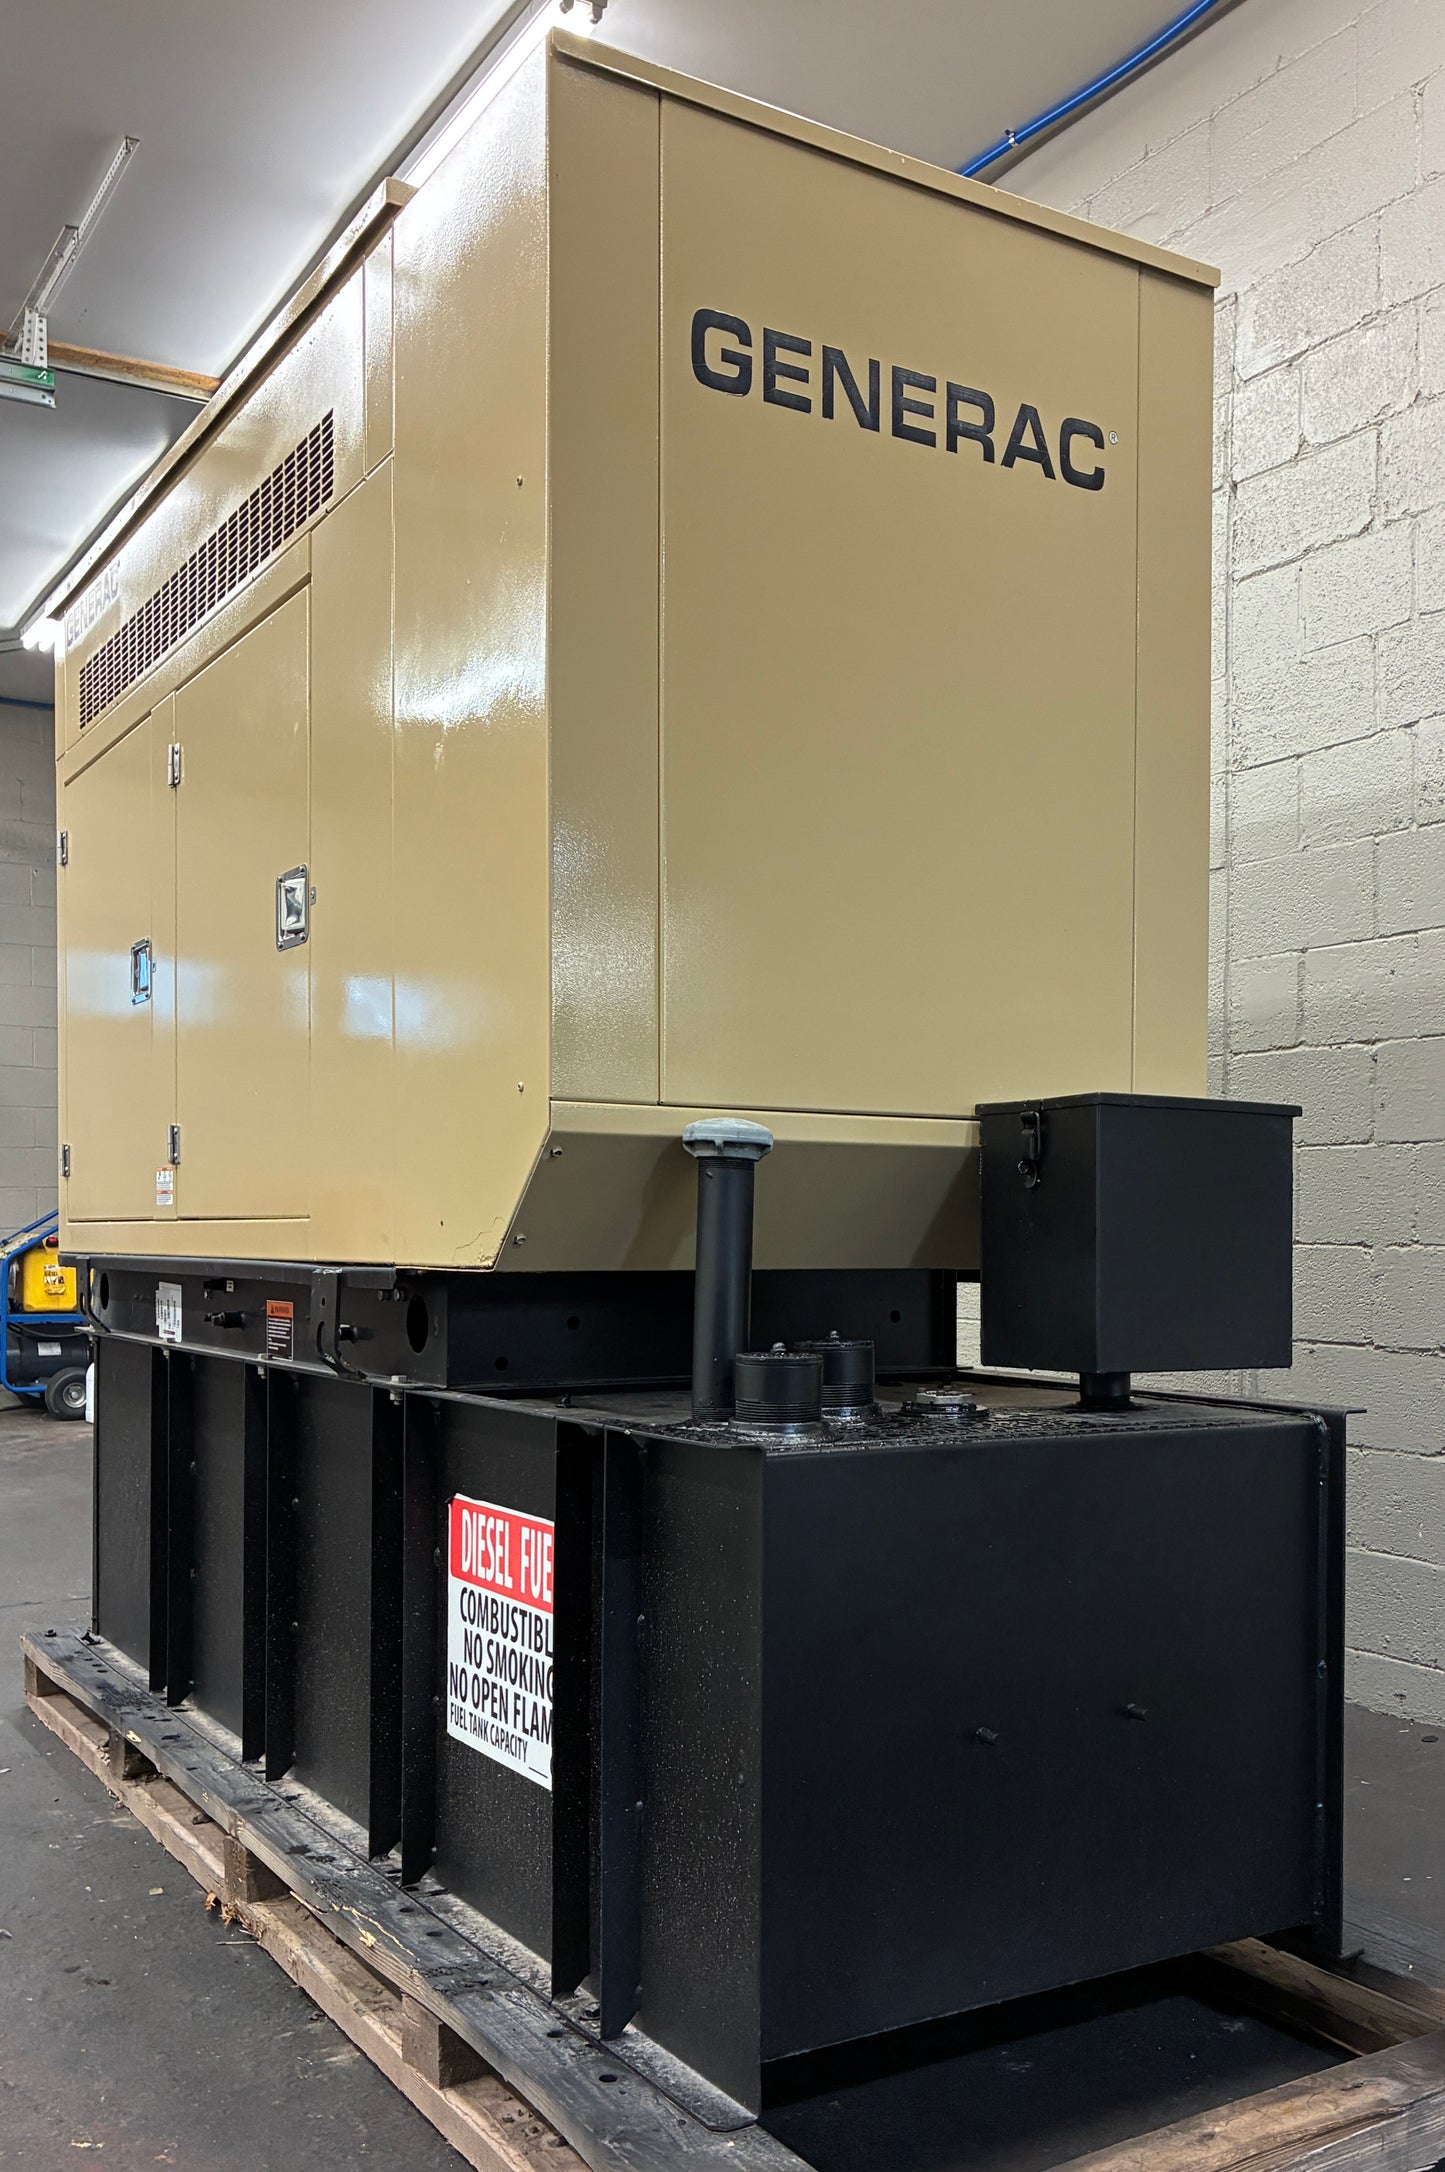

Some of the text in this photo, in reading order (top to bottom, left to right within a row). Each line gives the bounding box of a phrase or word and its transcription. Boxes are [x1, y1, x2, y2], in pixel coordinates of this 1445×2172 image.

[461, 1508, 553, 1603] DIESEL FUE
[460, 1586, 553, 1659] COMBUSTIBL
[464, 1627, 483, 1669] NO
[449, 1661, 553, 1745] NO OPEN FLAM
[450, 1701, 528, 1763] FUEL TANK CAPACITY
